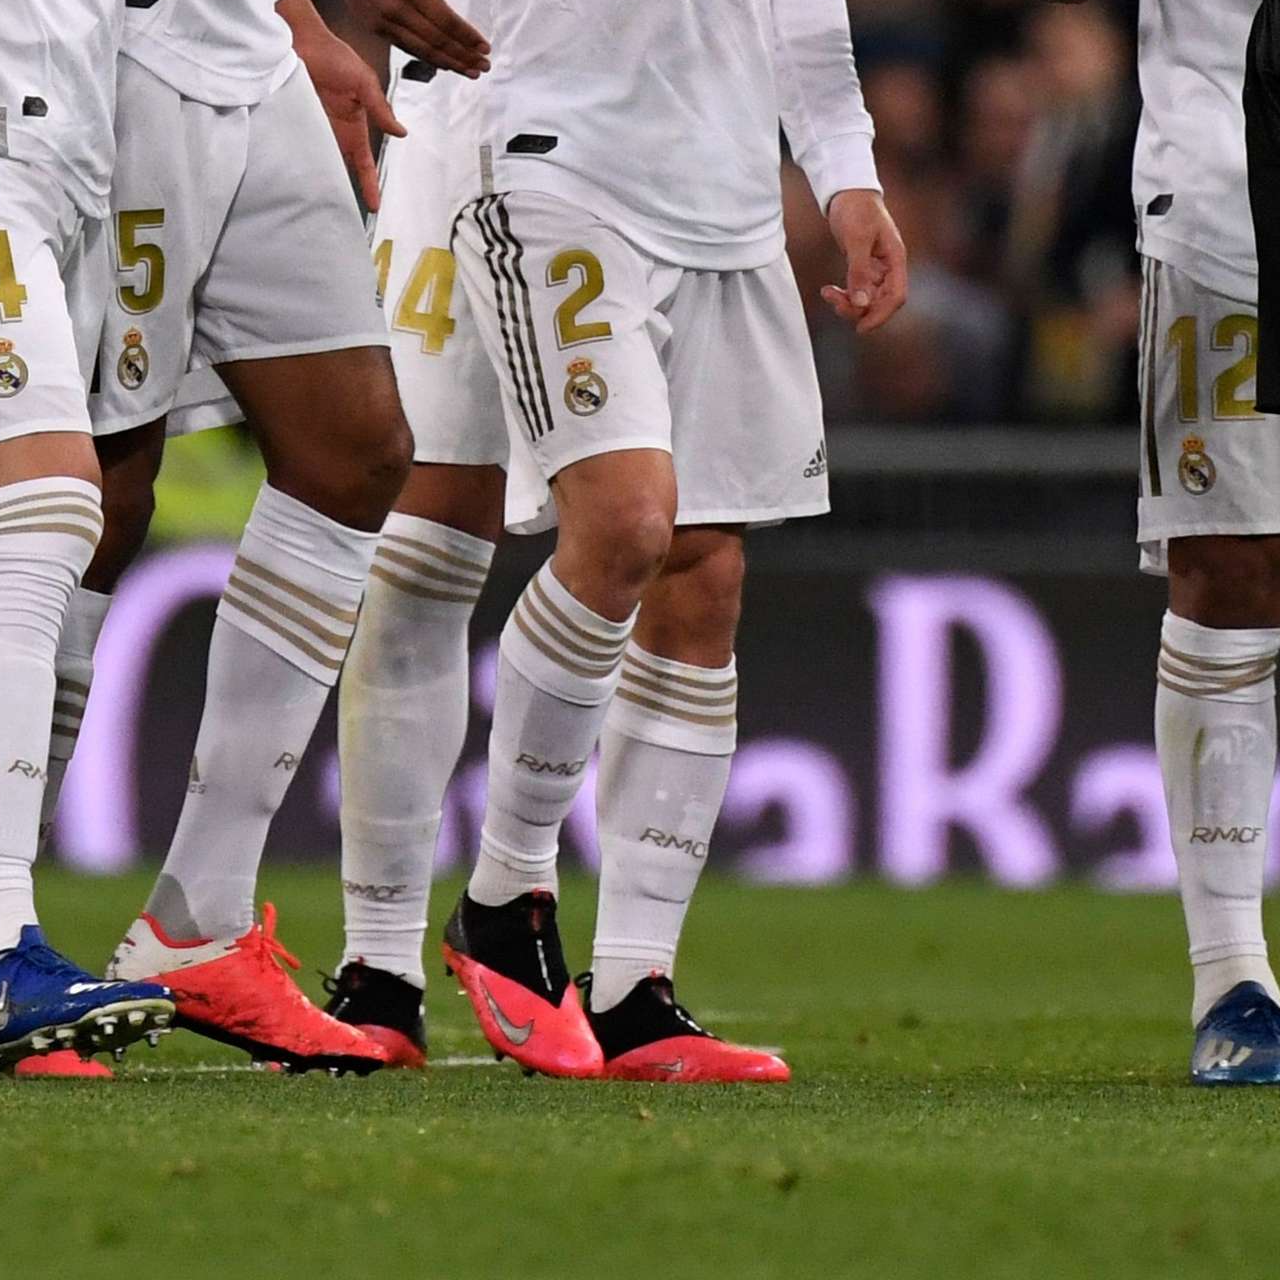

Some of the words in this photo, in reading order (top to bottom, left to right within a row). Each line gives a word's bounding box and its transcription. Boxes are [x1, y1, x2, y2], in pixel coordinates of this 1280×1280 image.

[114, 208, 165, 316] 5
[546, 248, 614, 351] 2
[1166, 314, 1266, 422] 12
[516, 752, 587, 777] RMC
[639, 827, 709, 859] RMC
[1189, 826, 1263, 845] RMCF
